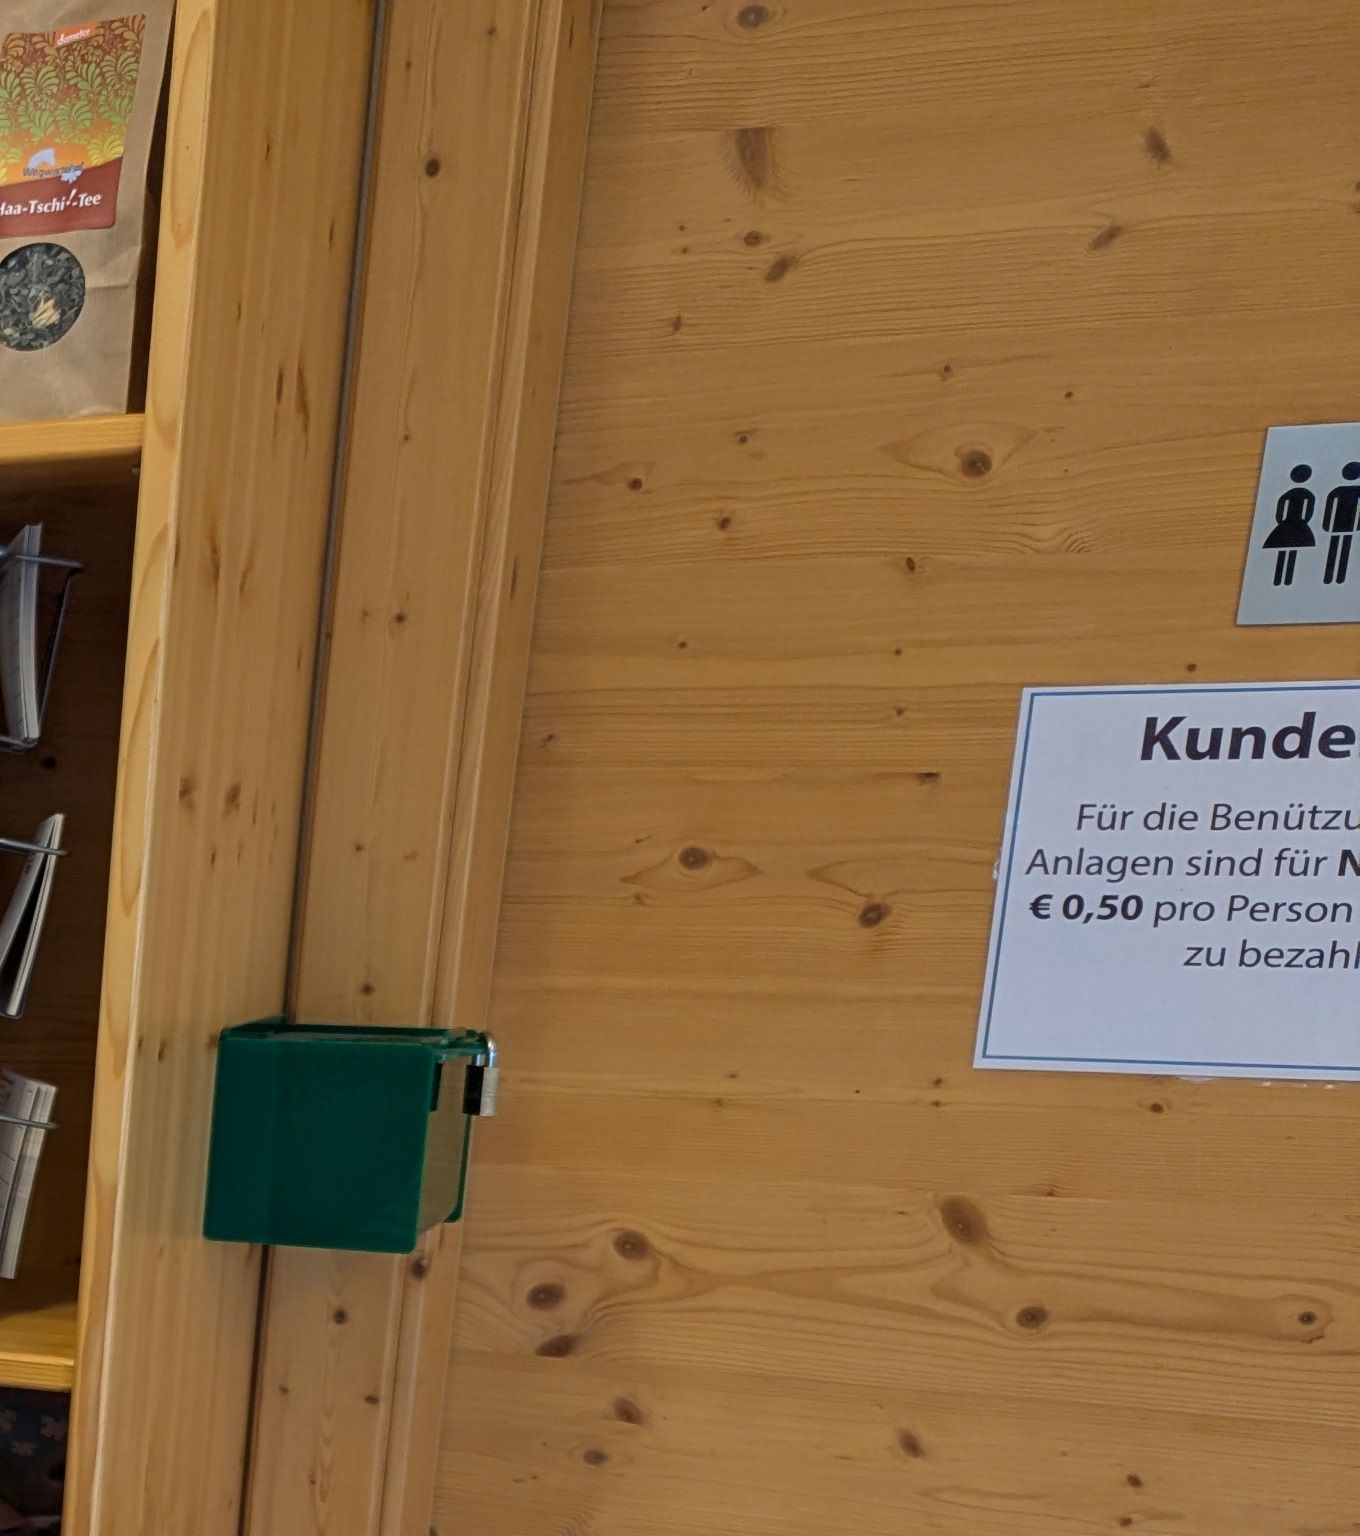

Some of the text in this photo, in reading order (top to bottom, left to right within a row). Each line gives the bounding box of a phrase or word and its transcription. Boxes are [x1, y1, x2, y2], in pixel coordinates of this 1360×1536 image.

[55, 27, 91, 46] demeter
[1077, 804, 1134, 831] Für
[1143, 802, 1199, 831] die
[1025, 848, 1174, 883] Anlagen
[1185, 848, 1263, 877] sind
[1274, 848, 1328, 877] für
[1030, 894, 1353, 928] € 0,50 pro Person
[1184, 946, 1226, 967] zu
